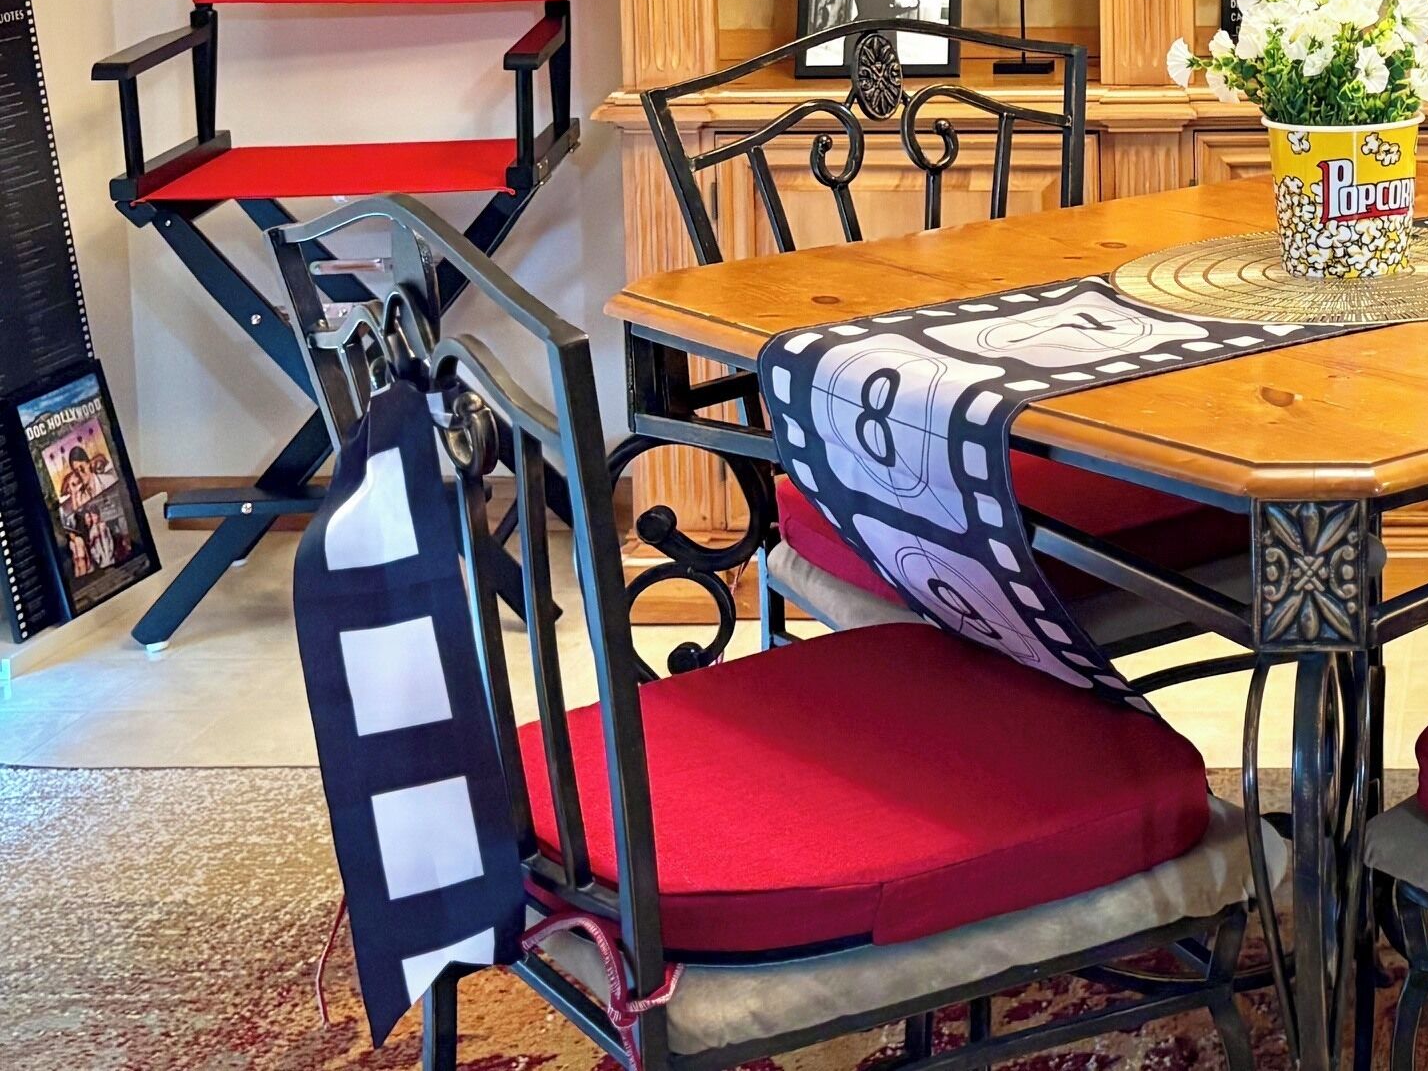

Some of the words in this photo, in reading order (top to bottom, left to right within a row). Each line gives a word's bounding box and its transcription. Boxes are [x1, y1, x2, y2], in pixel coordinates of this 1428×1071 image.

[26, 422, 47, 443] DOC
[46, 397, 102, 430] HOLLYWOOD
[854, 367, 901, 468] 8
